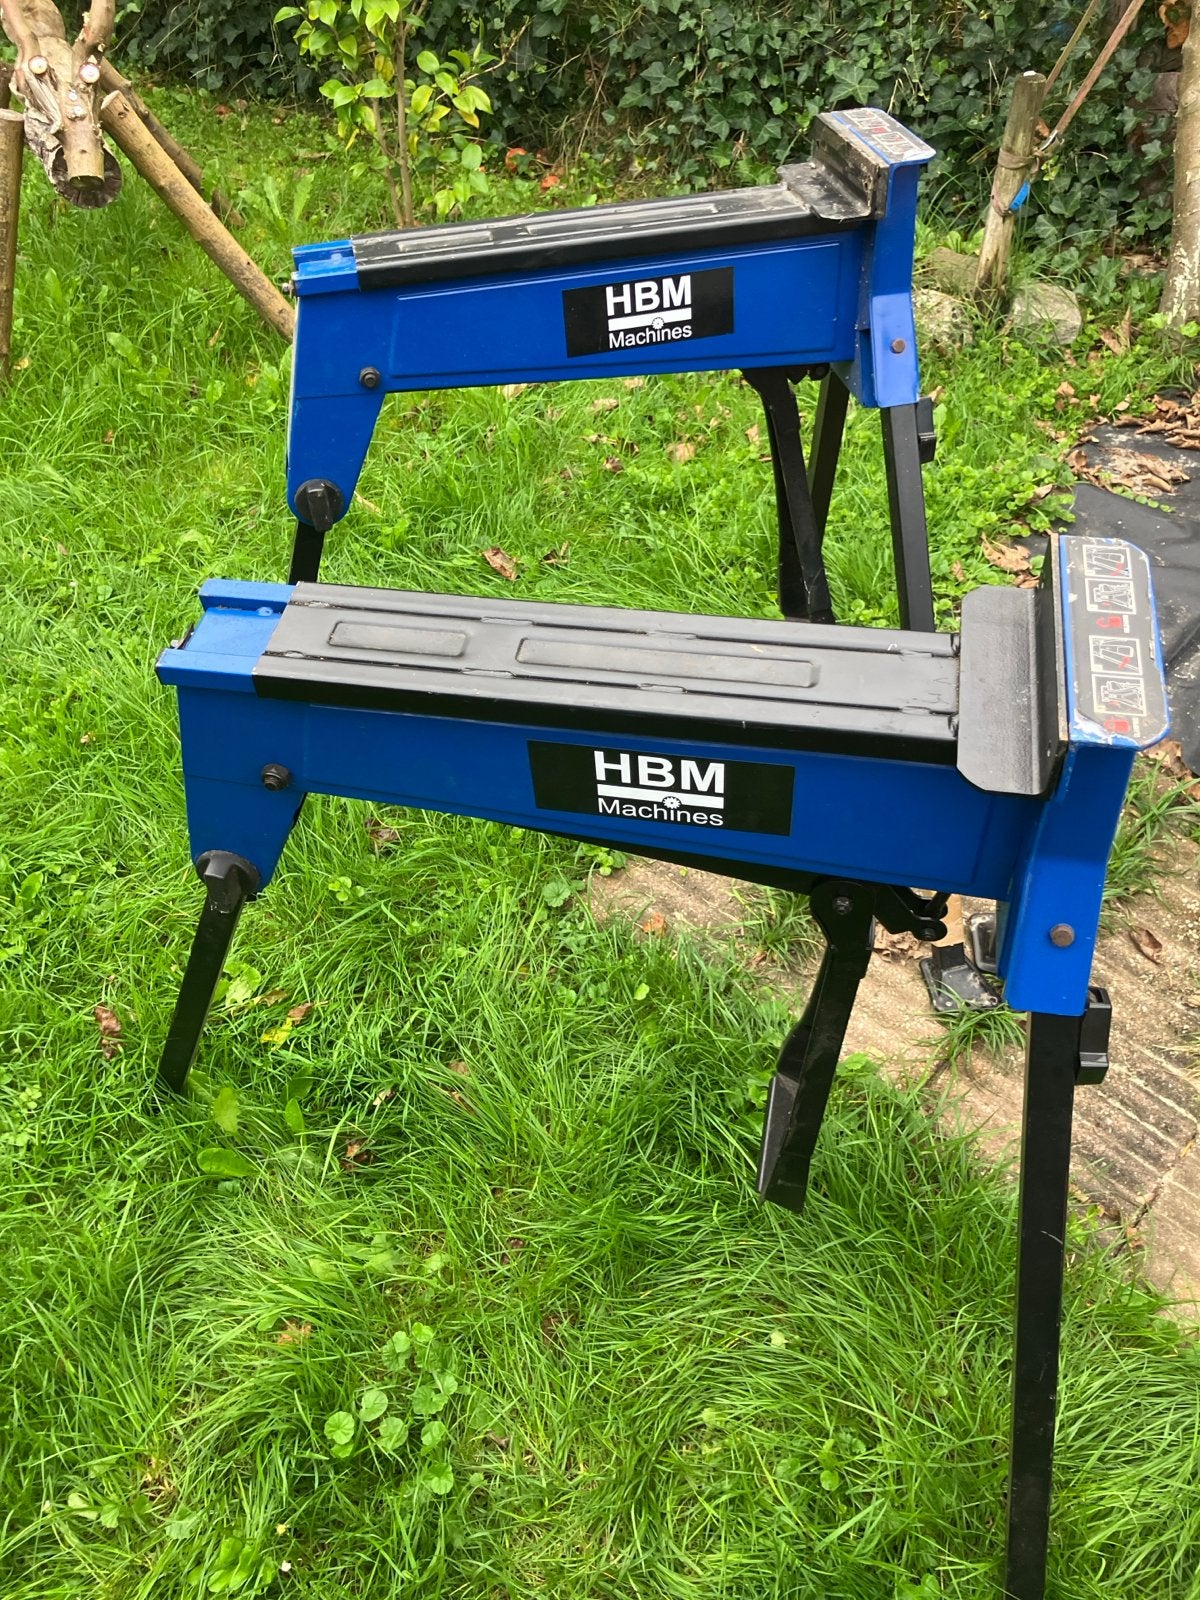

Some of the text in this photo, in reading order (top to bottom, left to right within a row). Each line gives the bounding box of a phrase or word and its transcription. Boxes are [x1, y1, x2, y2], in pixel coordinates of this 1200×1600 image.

[605, 274, 692, 317] HBM
[608, 325, 693, 349] Machines
[593, 750, 725, 794] HBM
[597, 797, 724, 826] Machines
